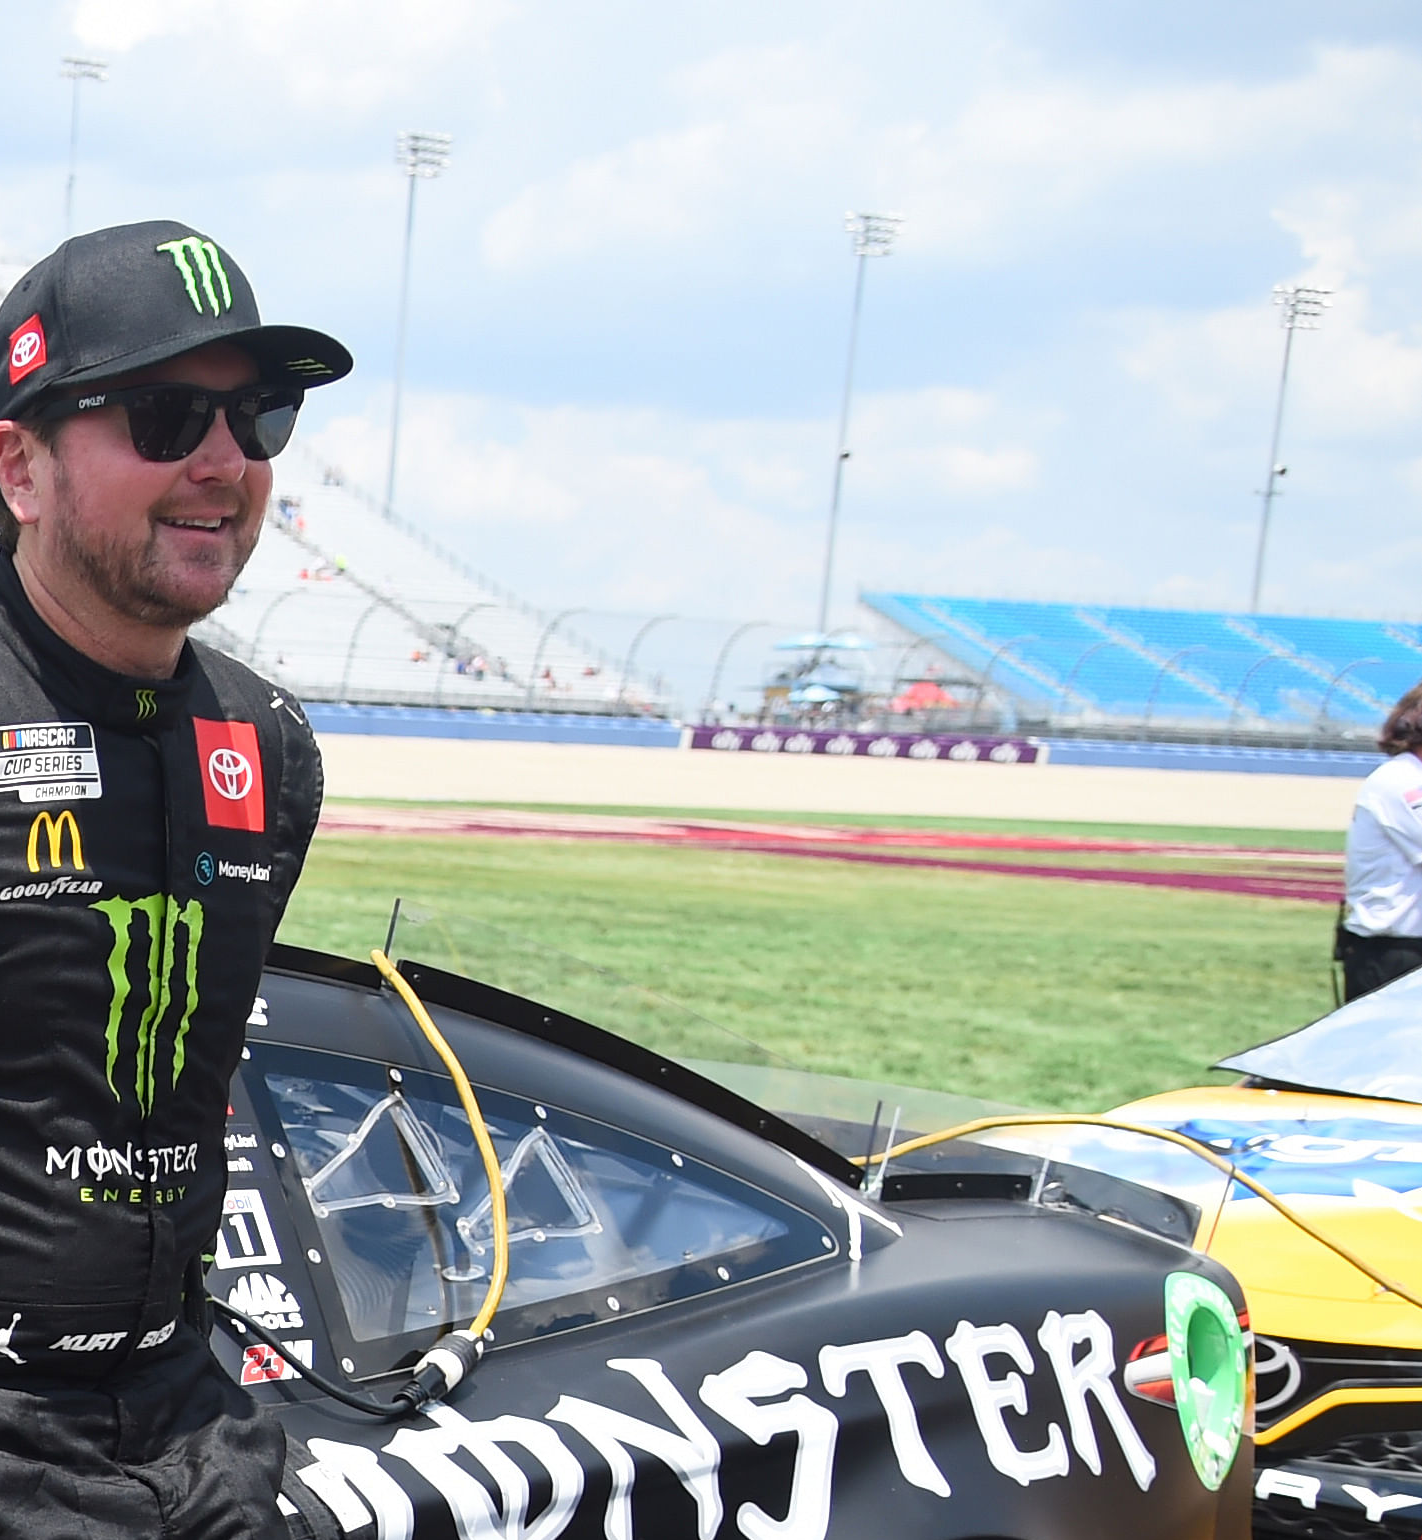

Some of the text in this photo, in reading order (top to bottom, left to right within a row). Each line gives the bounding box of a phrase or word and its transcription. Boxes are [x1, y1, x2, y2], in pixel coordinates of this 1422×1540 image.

[21, 727, 77, 749] NASCAR
[3, 755, 83, 776] CUP SERIES
[35, 784, 87, 799] CHAMPION
[79, 1185, 187, 1205] ENERGY
[224, 1198, 254, 1210] obil
[48, 1331, 129, 1352] KURT
